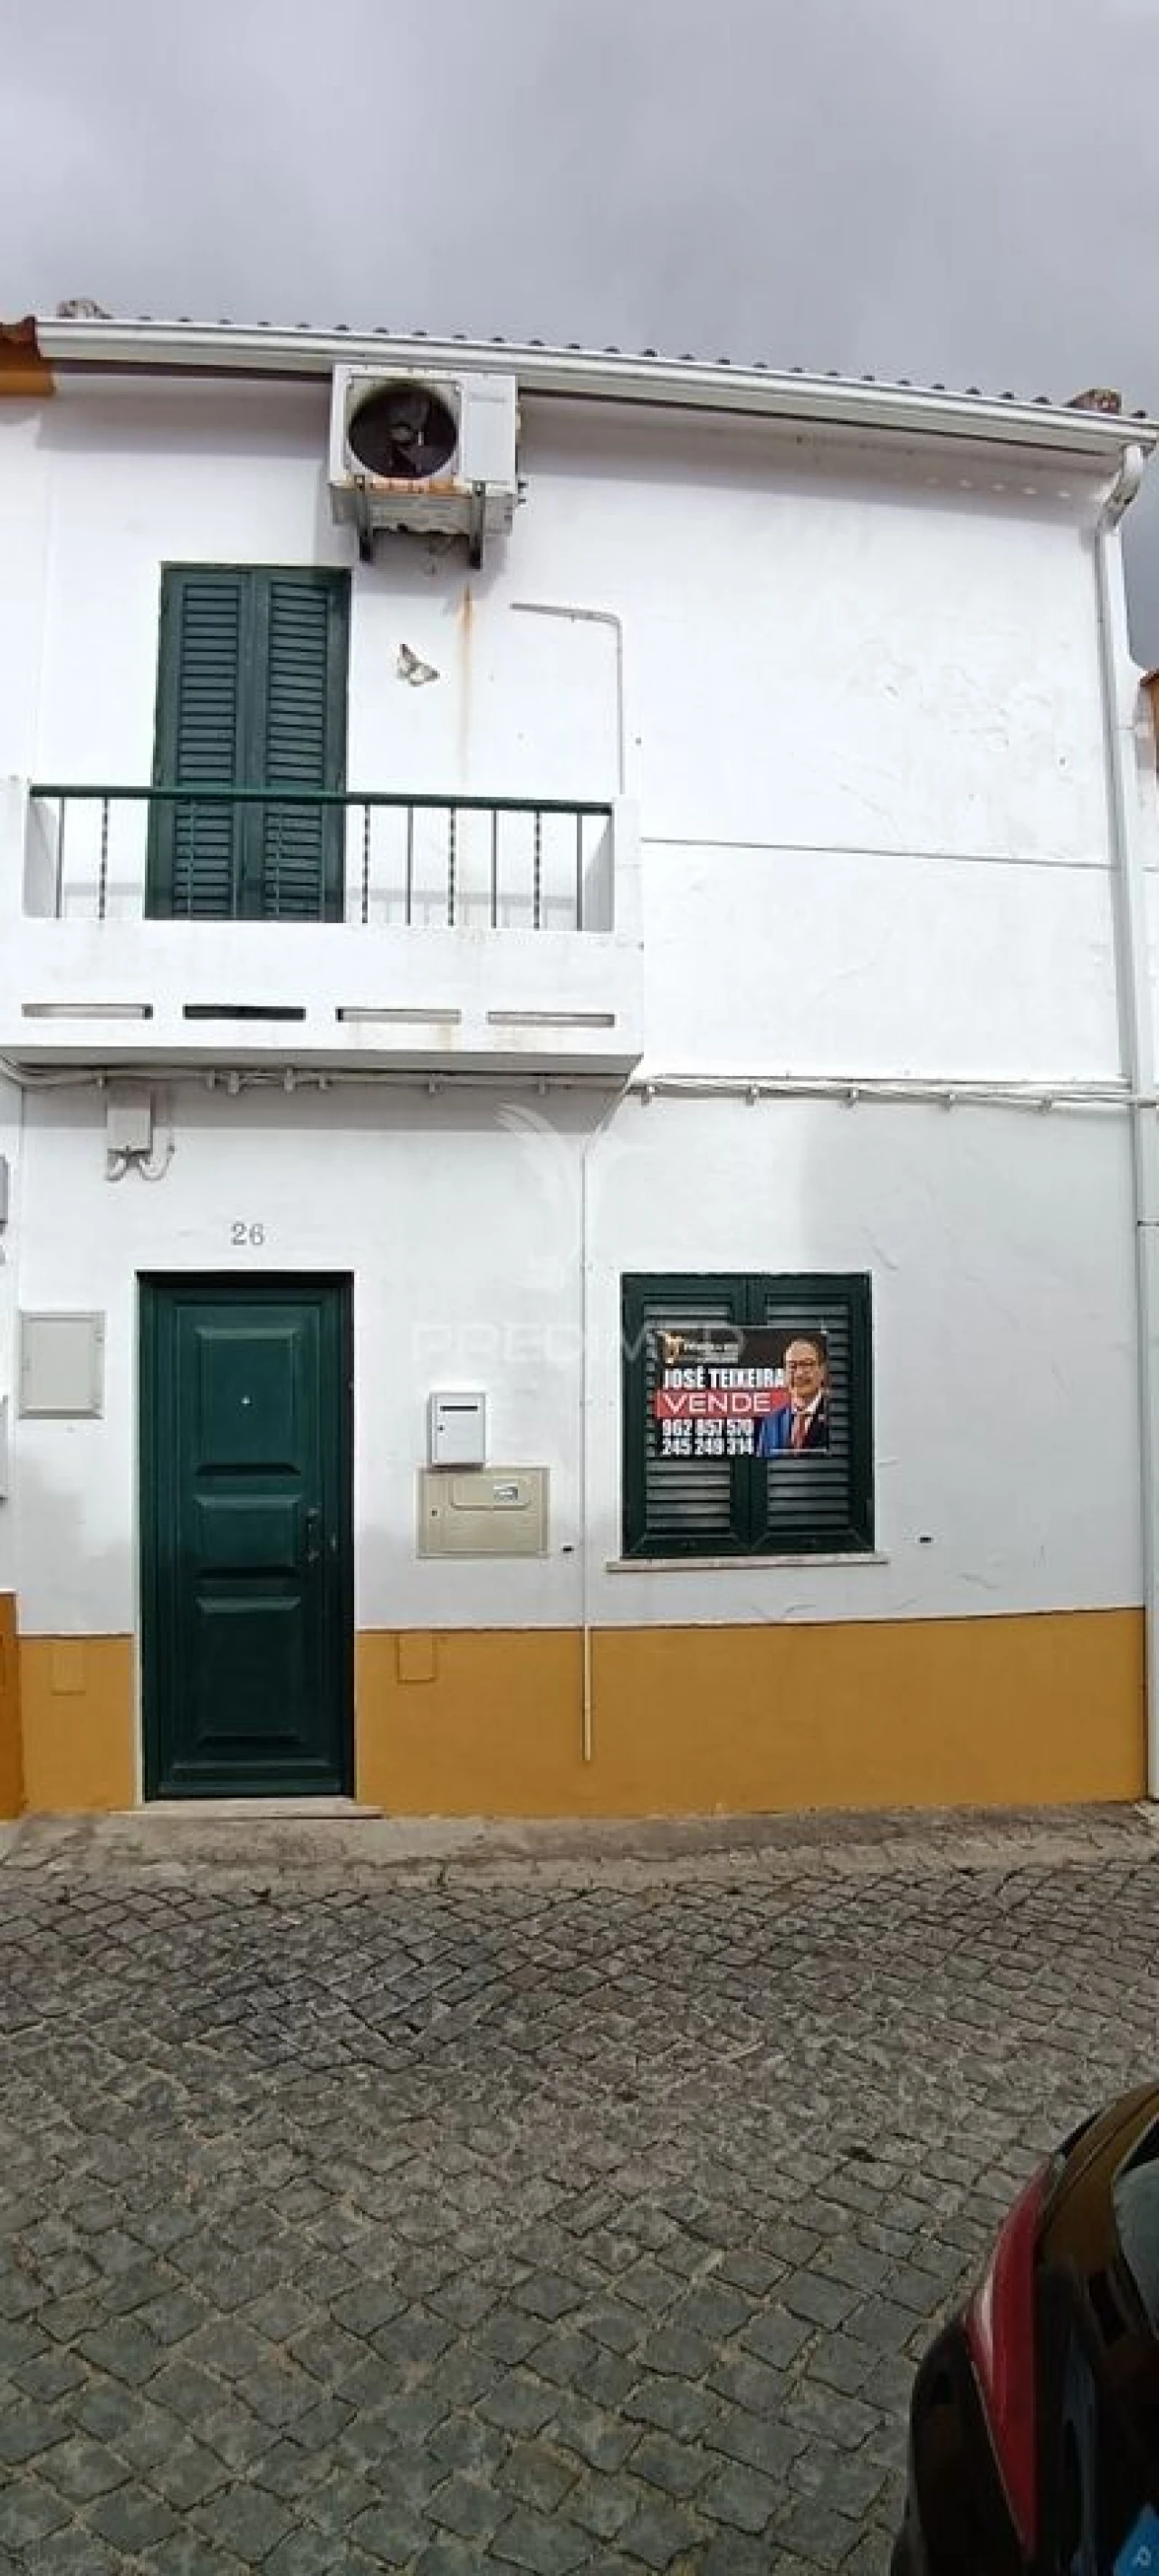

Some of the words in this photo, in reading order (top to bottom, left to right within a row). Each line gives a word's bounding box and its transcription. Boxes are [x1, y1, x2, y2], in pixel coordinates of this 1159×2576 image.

[231, 1222, 264, 1245] 26
[663, 1365, 705, 1388] JOSÉ
[707, 1368, 785, 1388] TEIXEIRA
[662, 1391, 771, 1413] VENDE
[662, 1419, 693, 1436] 962
[662, 1437, 693, 1455] 245
[726, 1437, 755, 1455] 314
